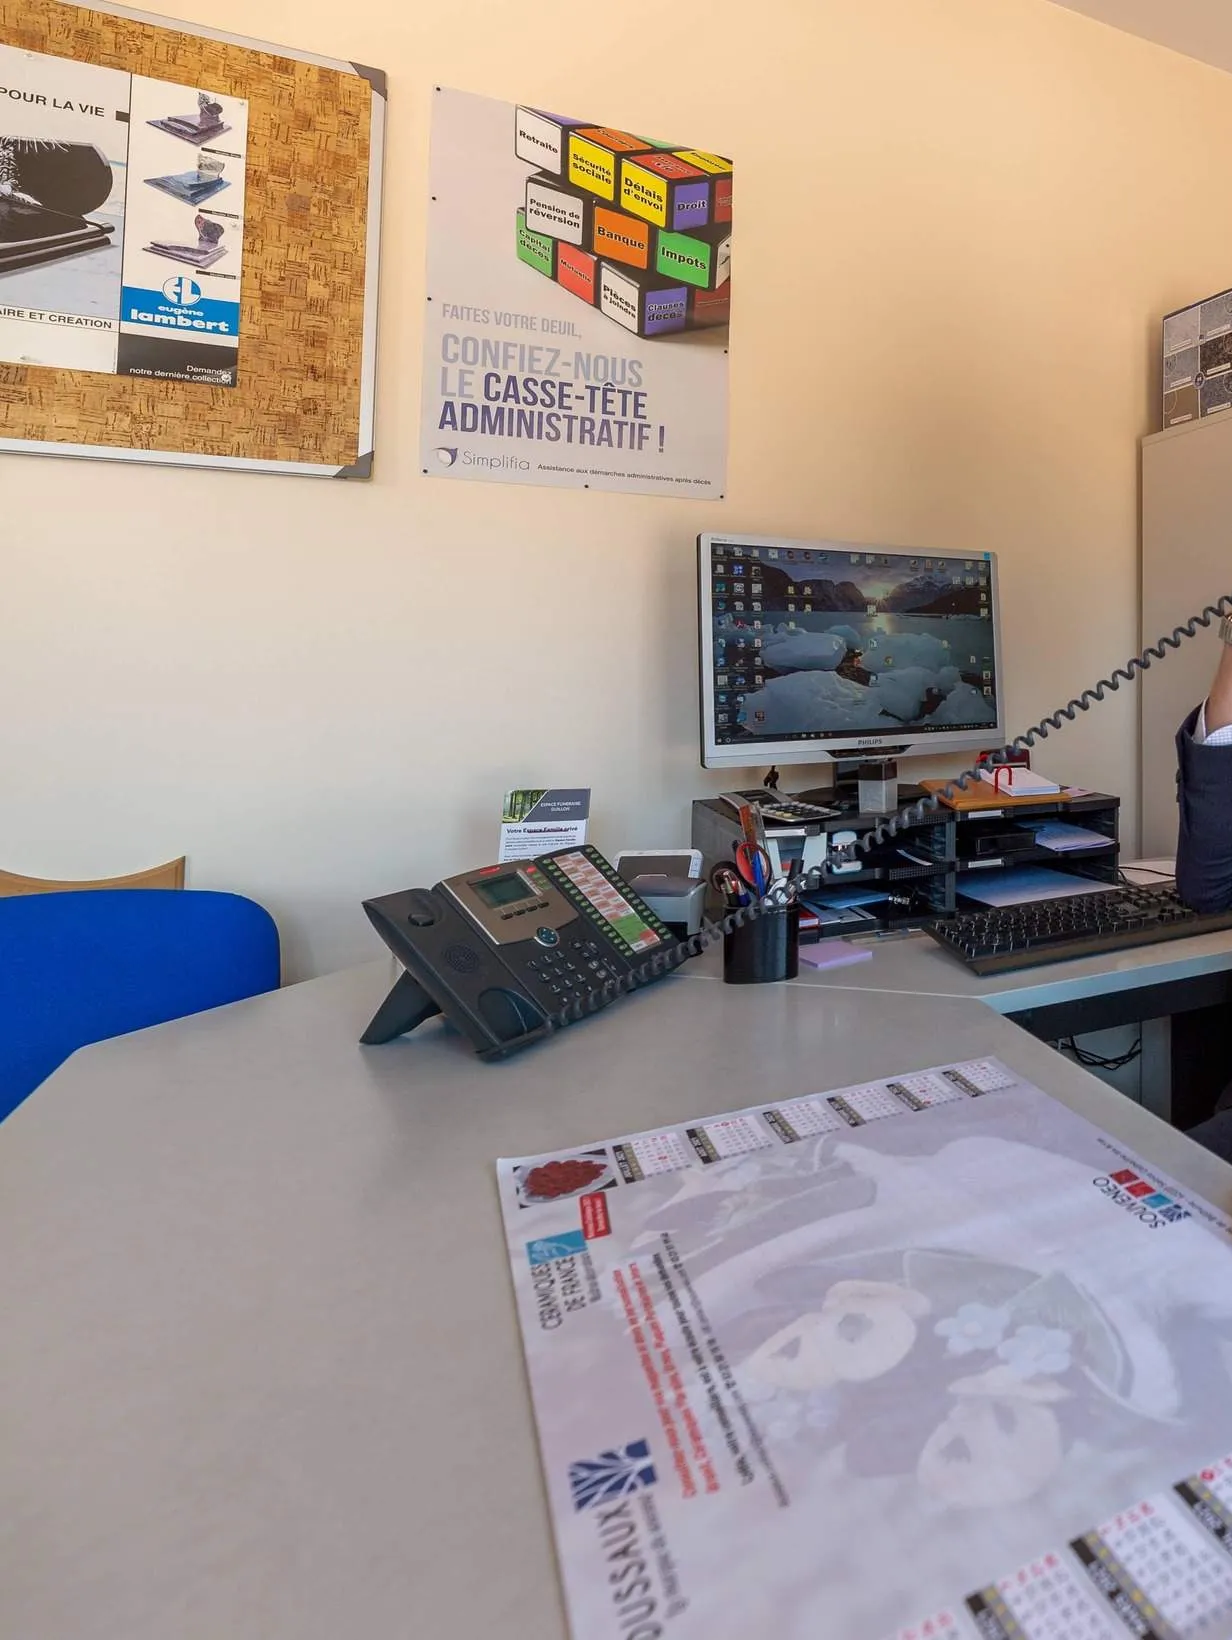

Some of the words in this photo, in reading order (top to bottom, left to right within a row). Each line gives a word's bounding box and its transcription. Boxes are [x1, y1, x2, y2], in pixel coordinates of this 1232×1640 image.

[53, 98, 73, 111] LA
[79, 103, 104, 117] VIE
[519, 129, 558, 153] Retraite
[572, 162, 612, 185] sociale
[573, 152, 612, 176] Sécurité
[623, 187, 663, 212] d'envoi
[624, 177, 663, 202] Délais
[529, 198, 567, 215] Pension
[568, 211, 580, 220] de
[677, 201, 706, 211] Droit
[529, 208, 580, 229] réversion
[520, 230, 550, 253] Capital
[597, 226, 645, 250] Banque
[603, 284, 636, 312] Pièces
[648, 301, 684, 312] Clauses
[29, 312, 45, 320] ET
[49, 315, 112, 329] CREATION
[131, 309, 229, 332] lambert
[158, 306, 204, 317] eugène
[442, 303, 489, 325] FAITES
[494, 311, 537, 331] VOTRE
[541, 316, 582, 339] DEUIL,
[442, 333, 643, 388] CONFIEZ-NOUS
[155, 369, 190, 379] dernière
[440, 367, 474, 398] LE
[484, 372, 647, 420] CASSE-TÊTE
[439, 401, 650, 451] ADMINISTRATIF
[659, 426, 665, 453] !
[462, 450, 530, 470] Simplifia
[1087, 1175, 1168, 1230] SOUVENEO
[554, 1255, 583, 1297] FRANCE
[563, 1295, 587, 1313] DE
